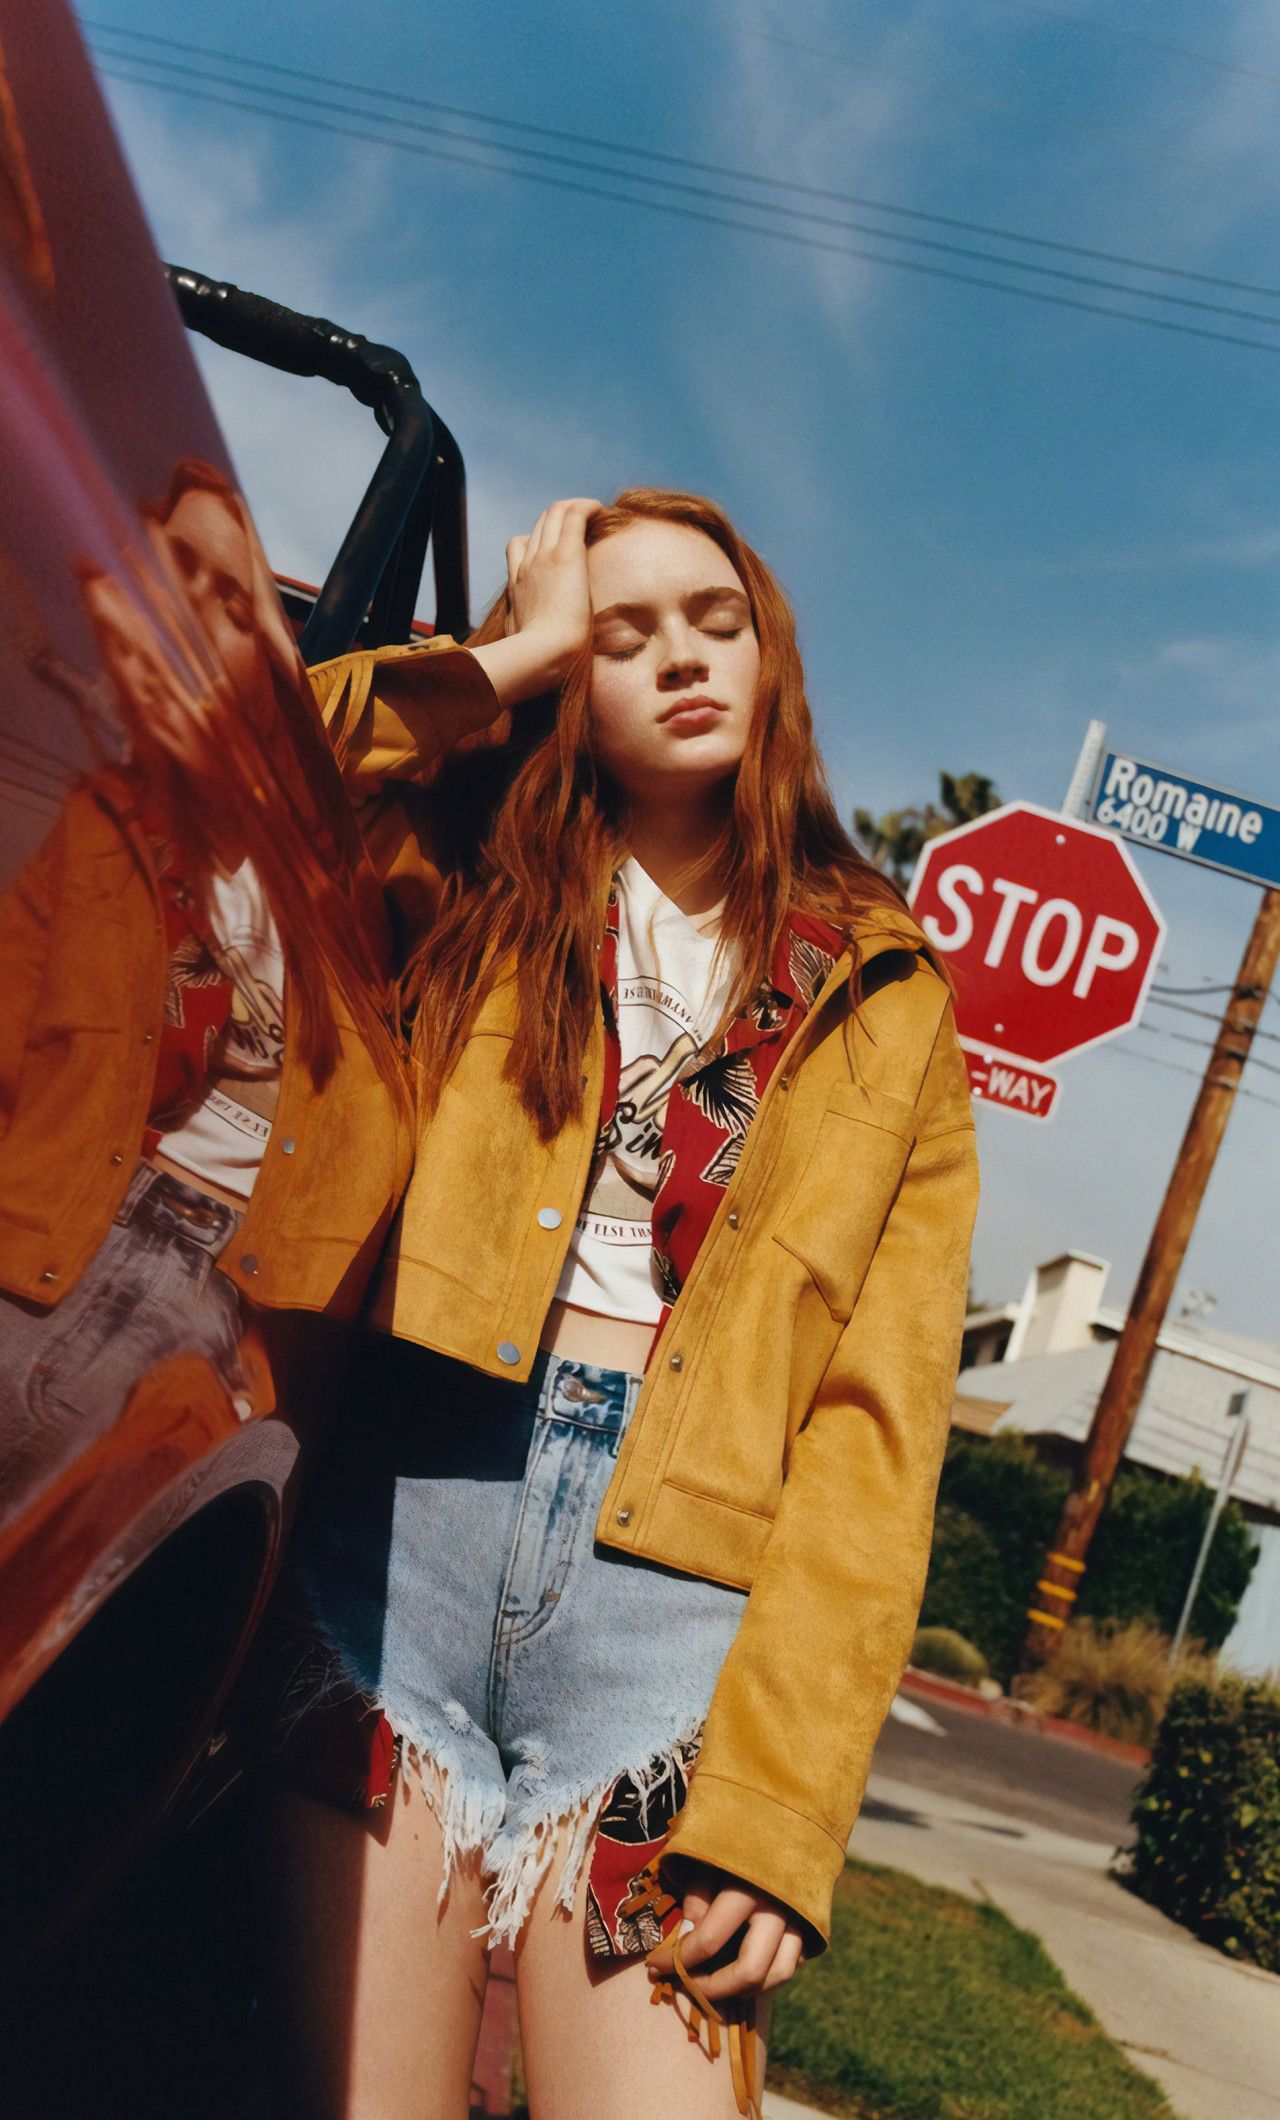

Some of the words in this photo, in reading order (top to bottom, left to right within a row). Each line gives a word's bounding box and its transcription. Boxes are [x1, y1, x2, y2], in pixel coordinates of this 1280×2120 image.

[1096, 797, 1169, 842] 6400
[1176, 820, 1202, 853] W
[1105, 757, 1263, 845] Romaine
[922, 863, 1140, 999] STOP
